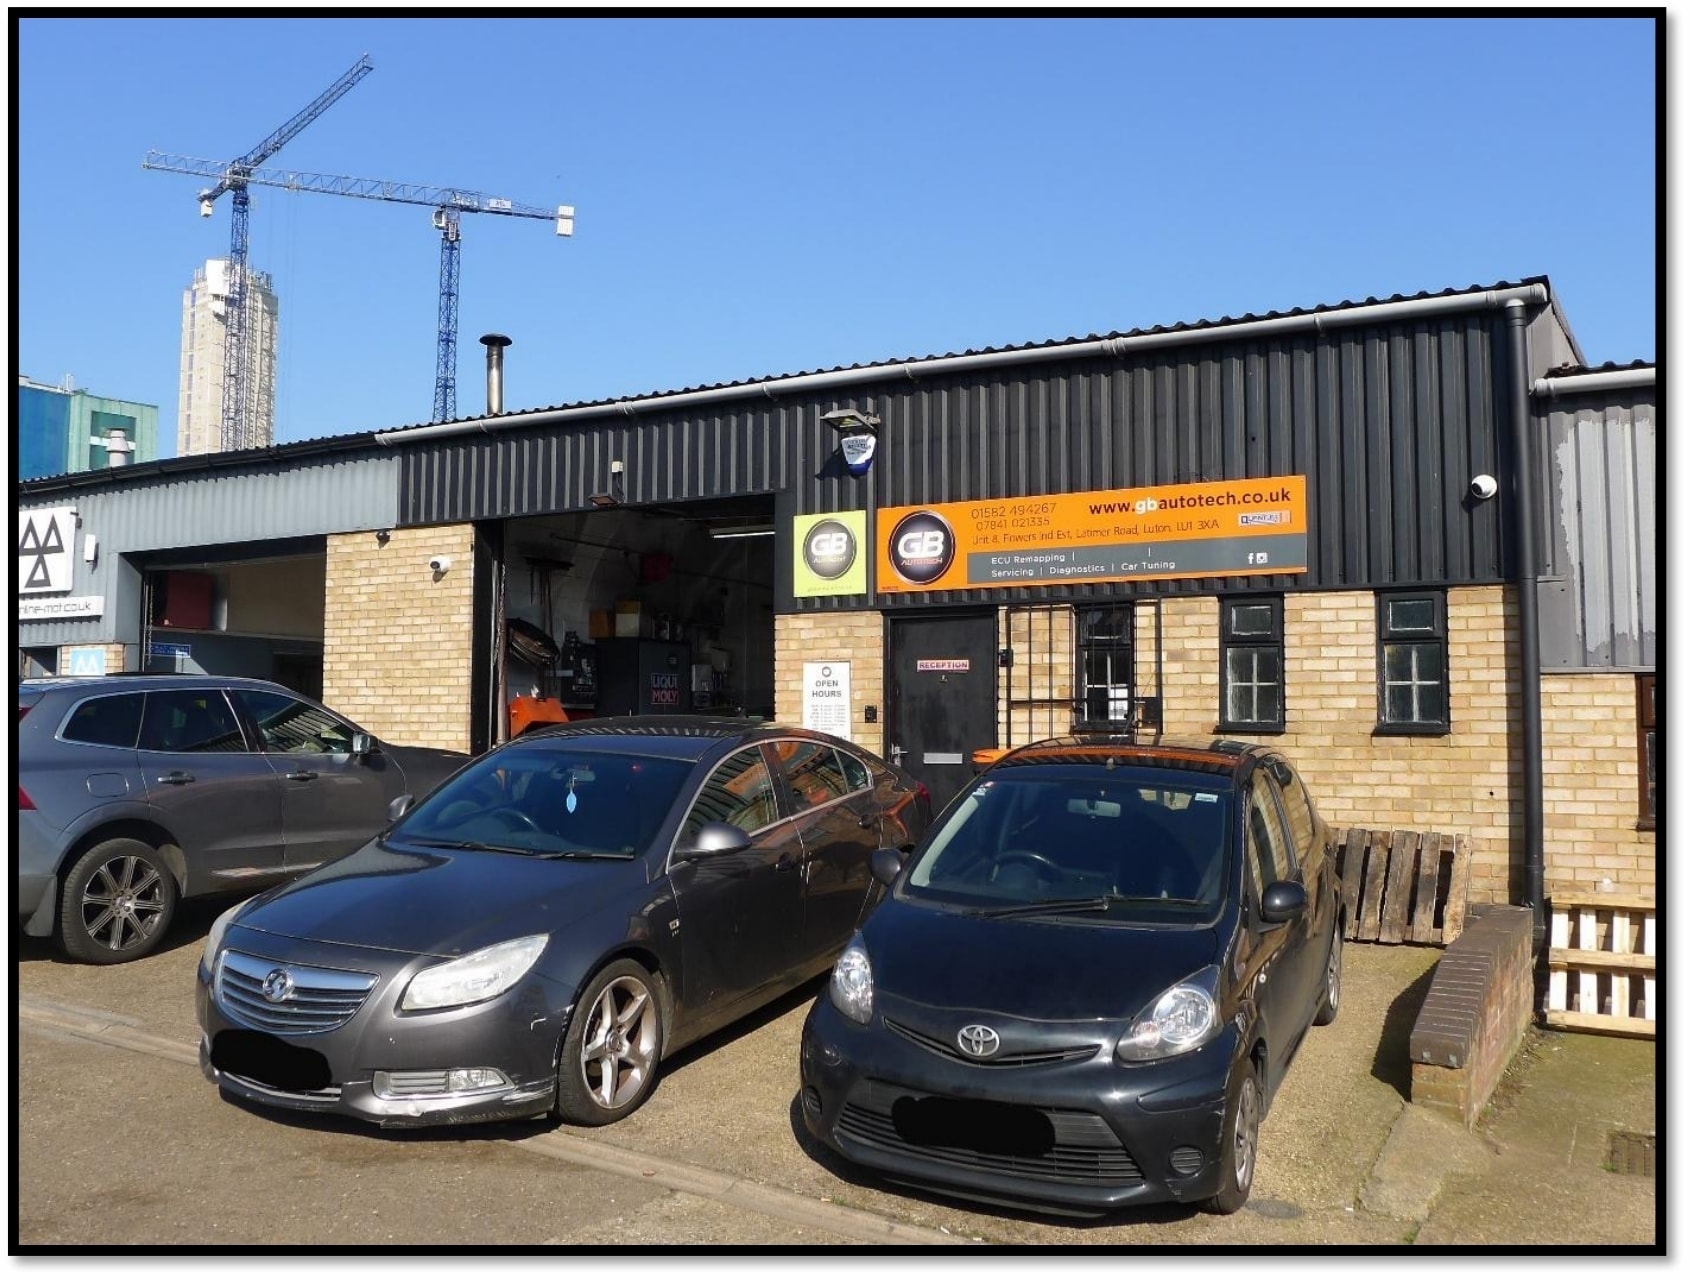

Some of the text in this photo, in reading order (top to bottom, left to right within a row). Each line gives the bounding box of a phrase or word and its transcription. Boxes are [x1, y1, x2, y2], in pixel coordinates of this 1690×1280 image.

[1089, 488, 1291, 515] www.gbautotech.co.uk
[971, 502, 1056, 519] 01582 494267
[976, 520, 1007, 531] 07841
[1198, 519, 1220, 530] 3XA
[810, 532, 848, 557] GB
[897, 531, 945, 559] GB
[991, 553, 1066, 565] ECU Remapping
[991, 560, 1176, 578] Servicing Diagnostics Car Tuning
[919, 661, 968, 669] RECEPTION
[652, 675, 678, 689] LIQUI
[815, 679, 839, 687] OPEN
[652, 688, 678, 702] MOLY
[812, 690, 842, 698] HOURS
